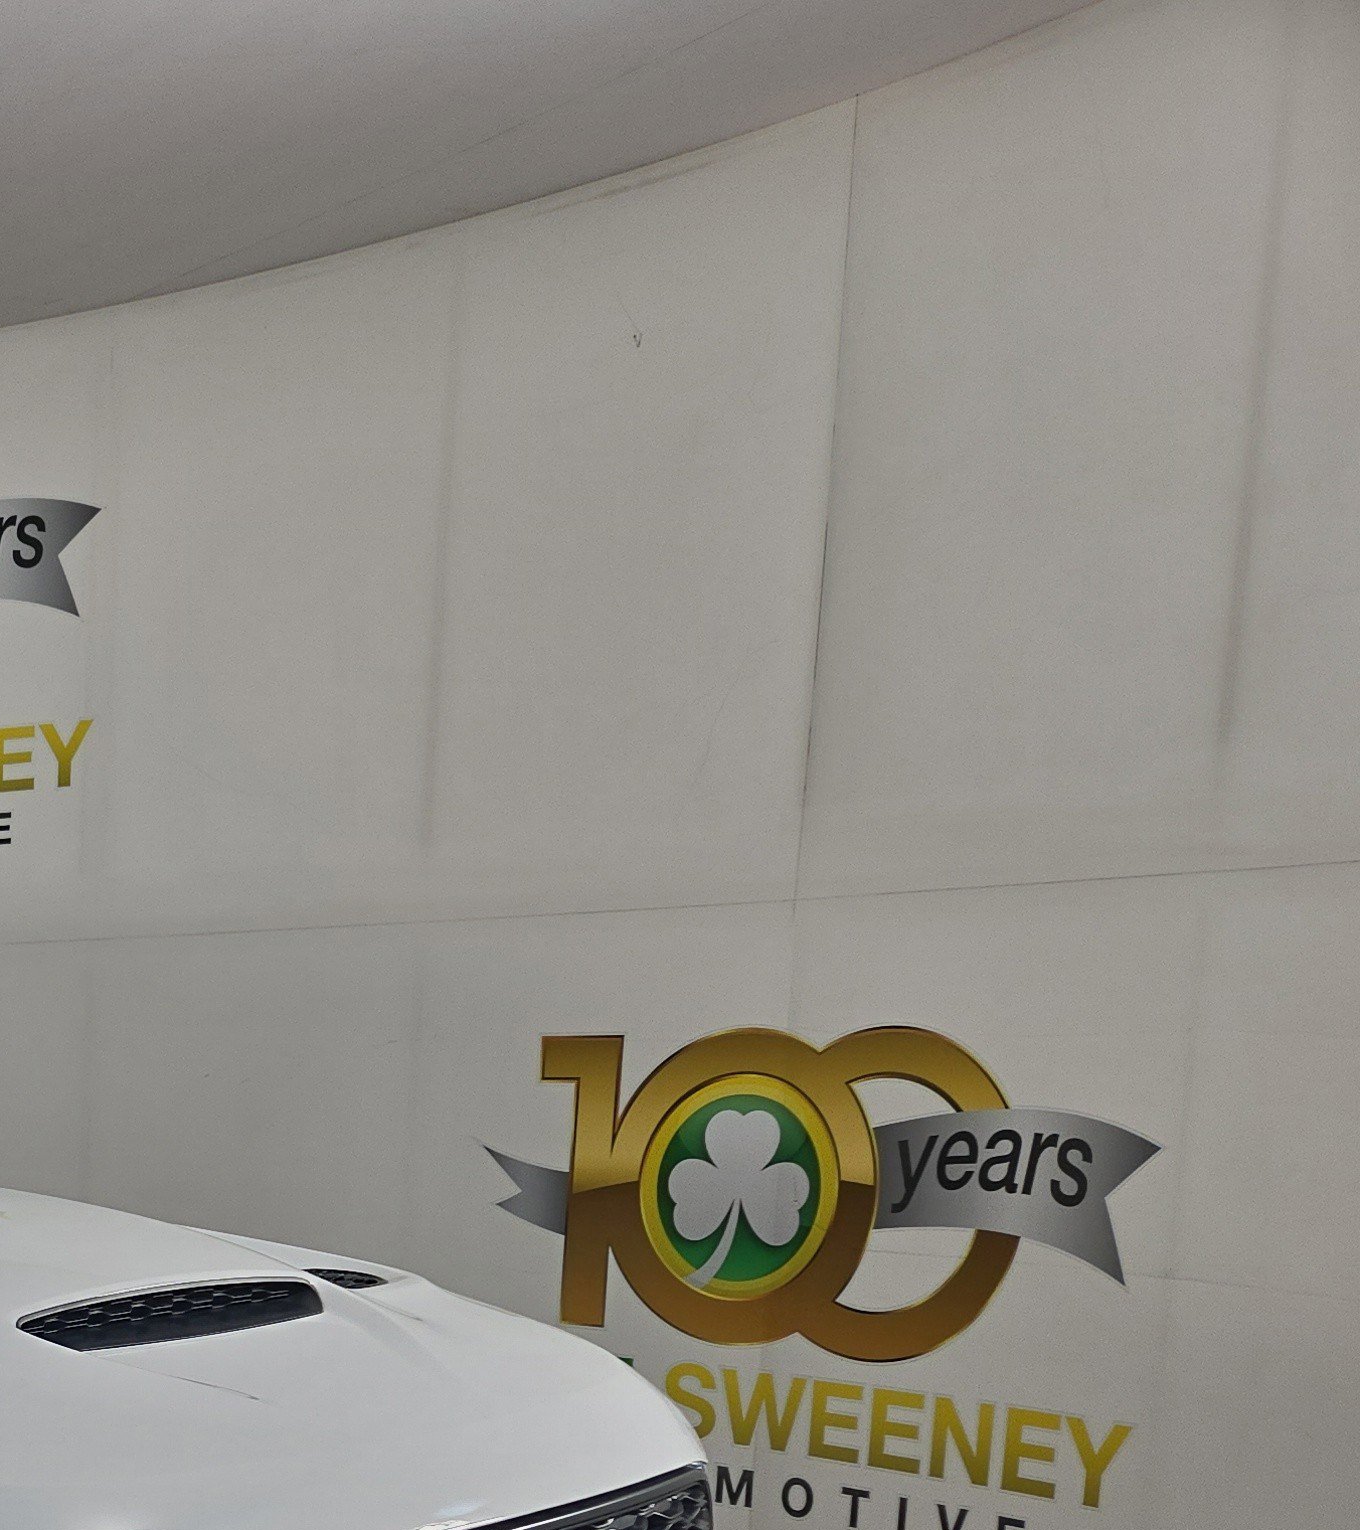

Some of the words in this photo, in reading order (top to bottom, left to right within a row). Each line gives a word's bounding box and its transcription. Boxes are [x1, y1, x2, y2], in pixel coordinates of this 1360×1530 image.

[541, 1025, 1020, 1363] 100
[890, 1127, 1093, 1213] years
[665, 1362, 1132, 1510] SWEENEY
